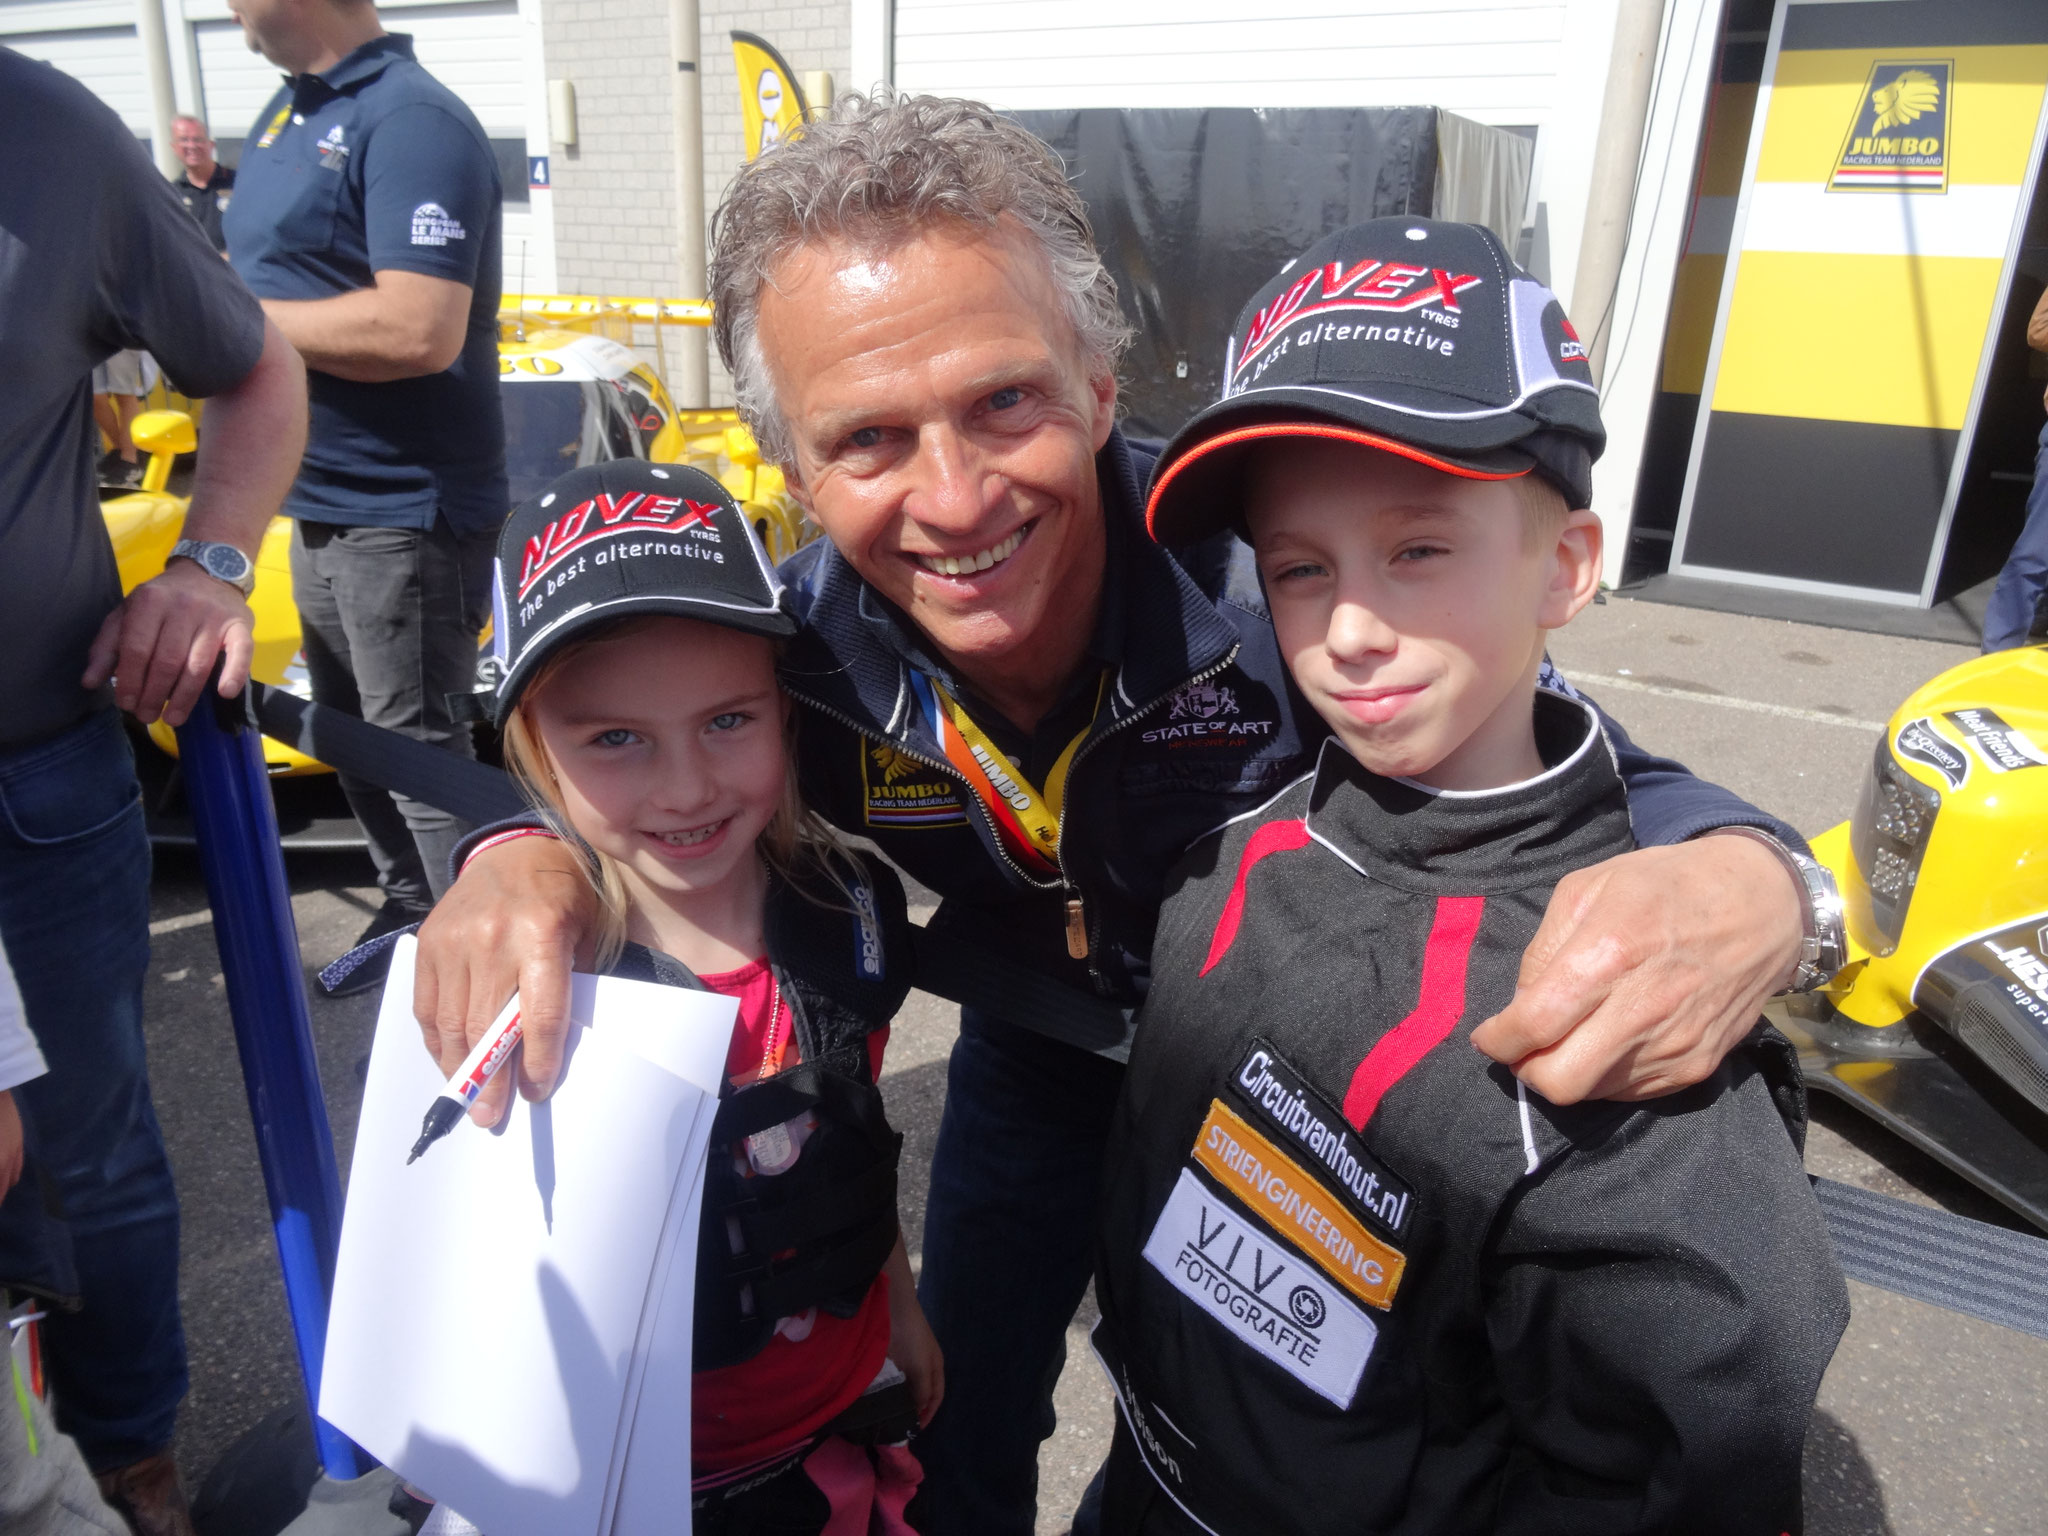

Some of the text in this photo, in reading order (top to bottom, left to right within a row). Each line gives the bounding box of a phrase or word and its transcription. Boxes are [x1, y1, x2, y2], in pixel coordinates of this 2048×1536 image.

[1843, 156, 1942, 166] RACING TEAM NEDERLAND
[1848, 137, 1939, 156] JUMBO
[533, 160, 546, 184] 4
[410, 235, 448, 246] SERIES
[411, 225, 466, 240] LE MANS
[1238, 259, 1482, 368] NOVEX
[1420, 308, 1460, 329] TYRES
[1253, 336, 1291, 381] best
[1298, 322, 1455, 357] alternative
[519, 490, 724, 588] NOVEX
[519, 541, 725, 627] The best alternative
[1142, 721, 1272, 742] STATE OF ART
[1954, 710, 2025, 769] Meat Friends
[1919, 736, 1962, 770] Greenery
[871, 783, 950, 799] JUMBO
[971, 743, 1031, 811] JUMBO
[869, 799, 896, 808] RACING
[897, 798, 917, 807] TEAM
[1239, 1050, 1407, 1231] Circuitvanhout.nl
[1205, 1124, 1384, 1286] STRIENGINEERING
[1174, 1249, 1319, 1367] FOTOGRAFIE
